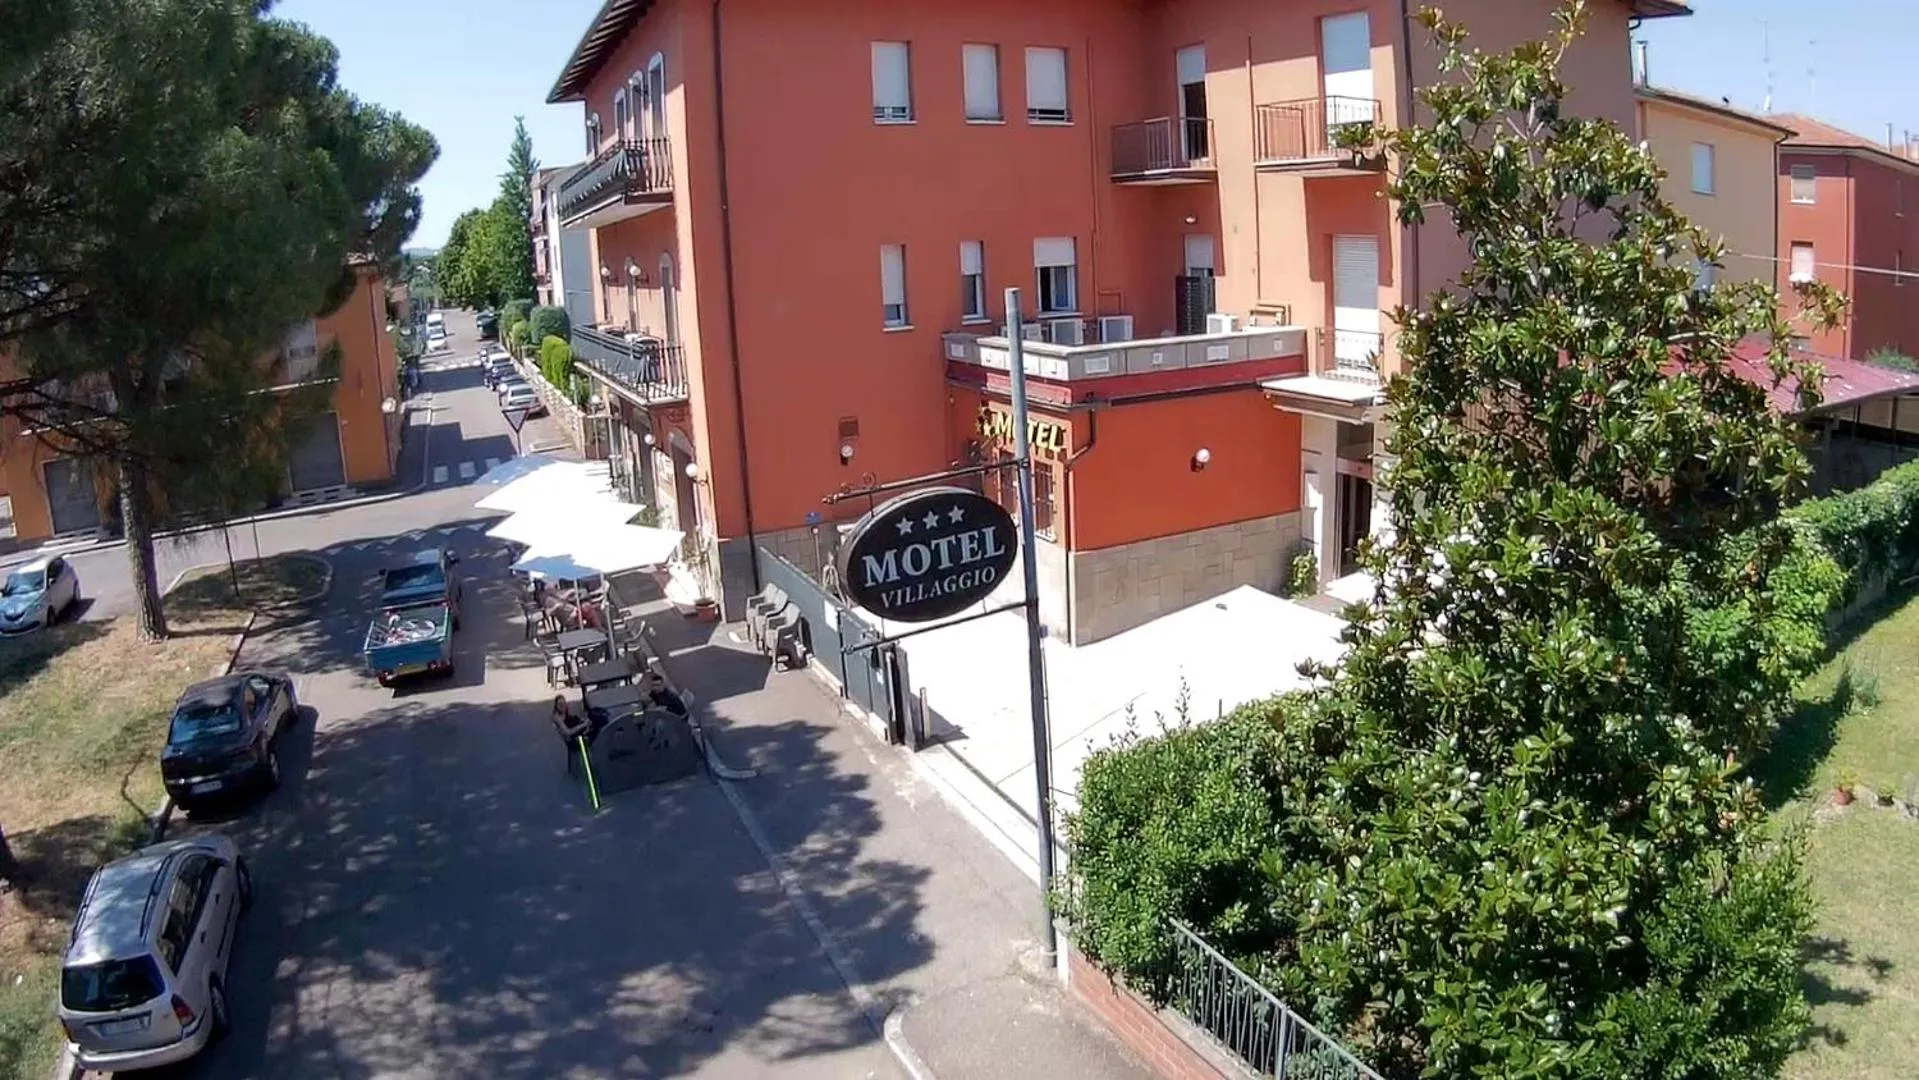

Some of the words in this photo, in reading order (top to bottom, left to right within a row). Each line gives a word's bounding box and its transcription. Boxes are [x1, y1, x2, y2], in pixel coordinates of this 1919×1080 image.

[995, 410, 1062, 453] MTEL
[862, 526, 1006, 588] MOTEL
[881, 566, 996, 609] VILLAGGIO
